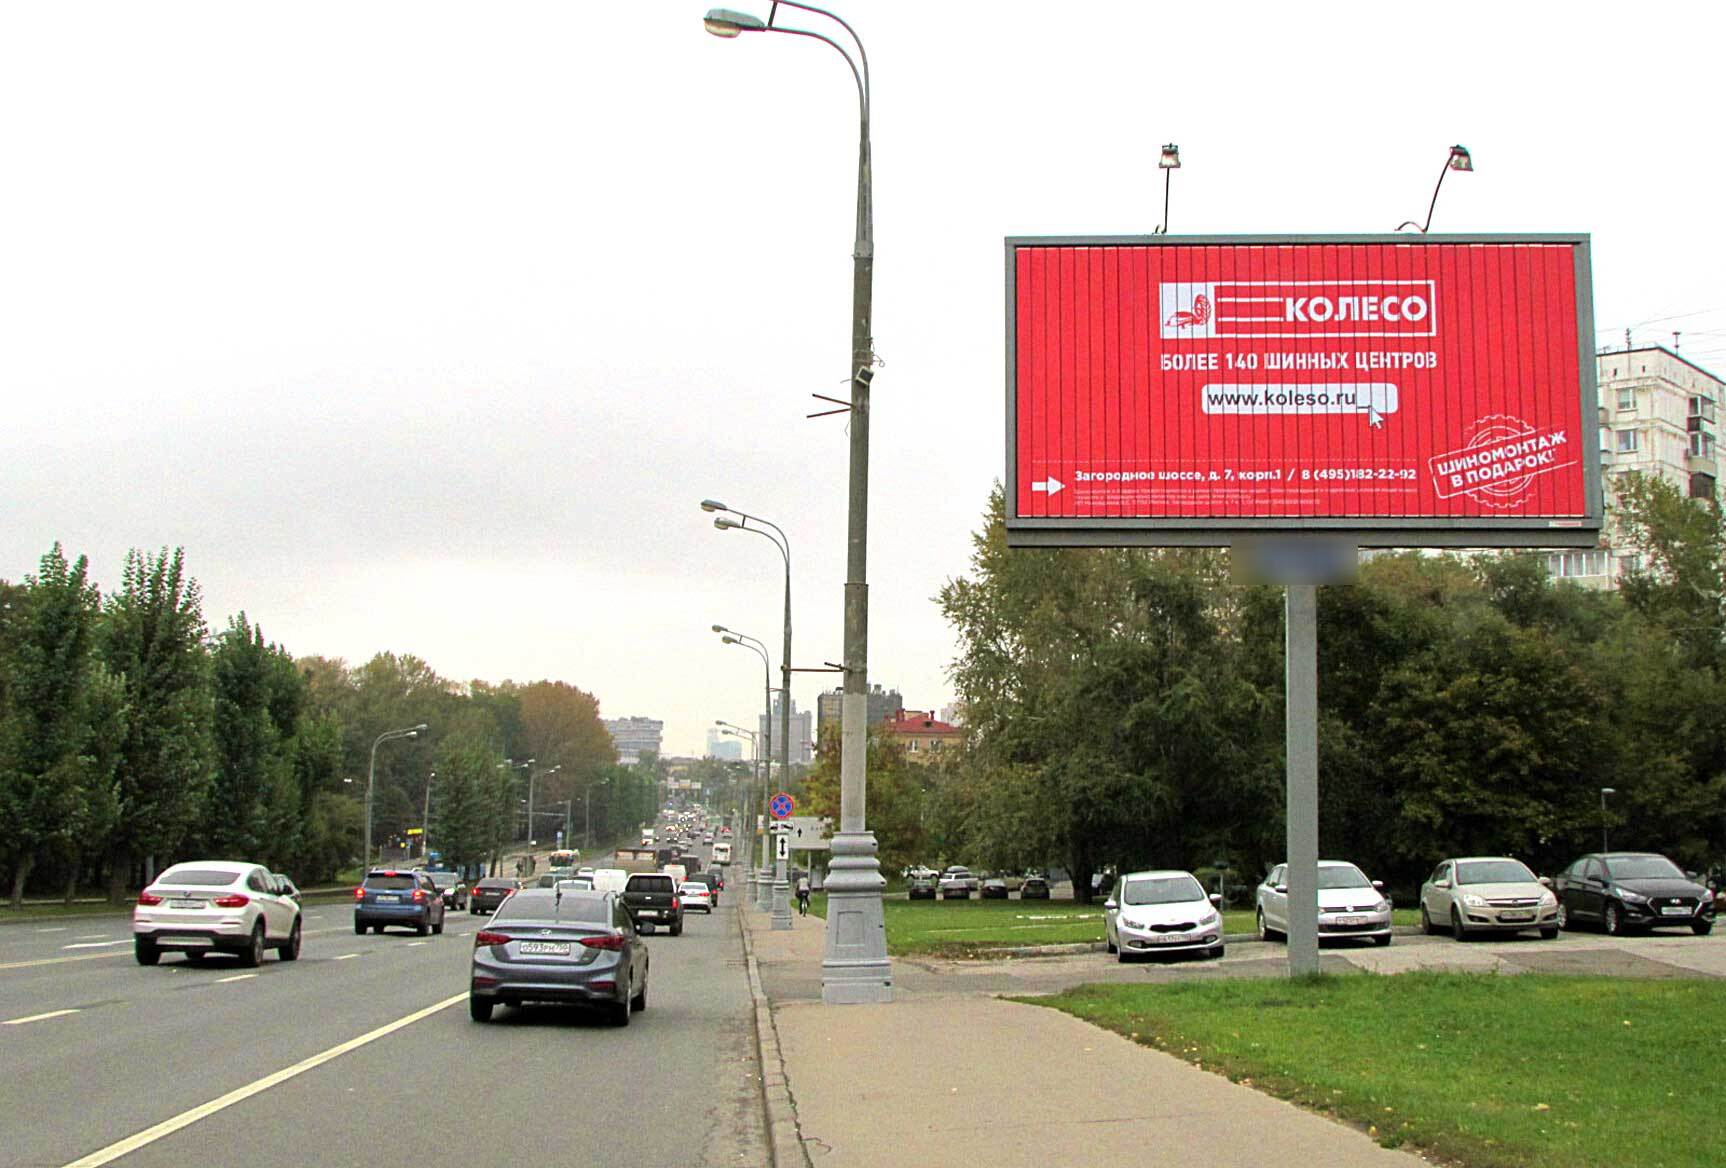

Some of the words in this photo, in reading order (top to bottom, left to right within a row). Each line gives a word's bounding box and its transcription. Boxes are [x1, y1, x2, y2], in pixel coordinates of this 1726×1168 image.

[1285, 295, 1428, 322] КОЛЕСО
[1160, 353, 1218, 371] БОЛЕЕ
[1225, 352, 1258, 370] 140
[1263, 351, 1349, 370] ШИННЫХ
[1355, 350, 1437, 372] ЦЕНТРОВ
[1437, 431, 1567, 476] ШИНОМОНТАЖ
[1075, 470, 1155, 482] Загородное
[1158, 471, 1205, 482] шоссе,
[1208, 470, 1221, 481] д.
[1223, 469, 1235, 481] 7,
[1238, 469, 1281, 482] корп.1
[1301, 469, 1310, 480] 8
[1450, 475, 1464, 488] В
[1465, 449, 1556, 484] ПОДАРОК!
